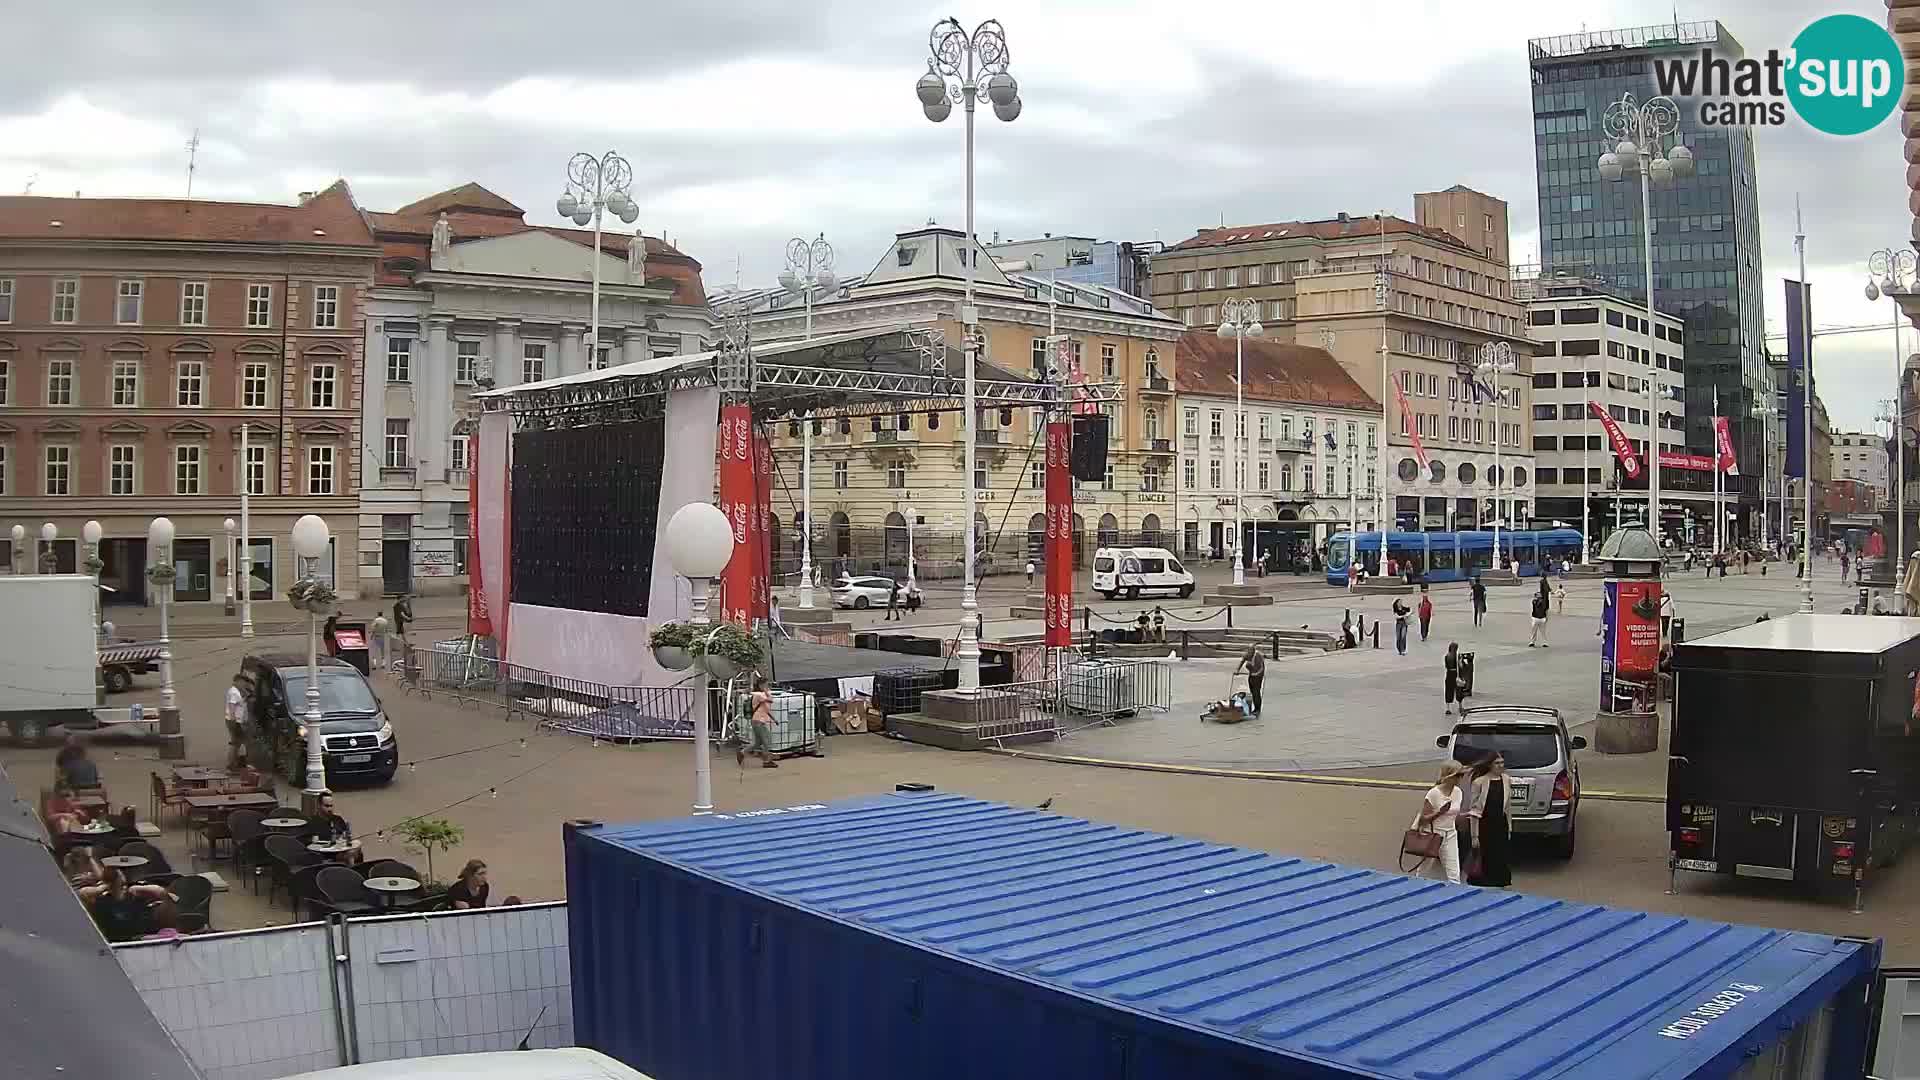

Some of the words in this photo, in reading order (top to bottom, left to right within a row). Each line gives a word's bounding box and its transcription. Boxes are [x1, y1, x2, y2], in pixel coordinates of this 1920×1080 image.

[735, 417, 747, 460] Coca-Cola
[1137, 492, 1167, 503] SINGER
[735, 501, 747, 544] Coca-Cola
[1691, 990, 1747, 1019] 300629
